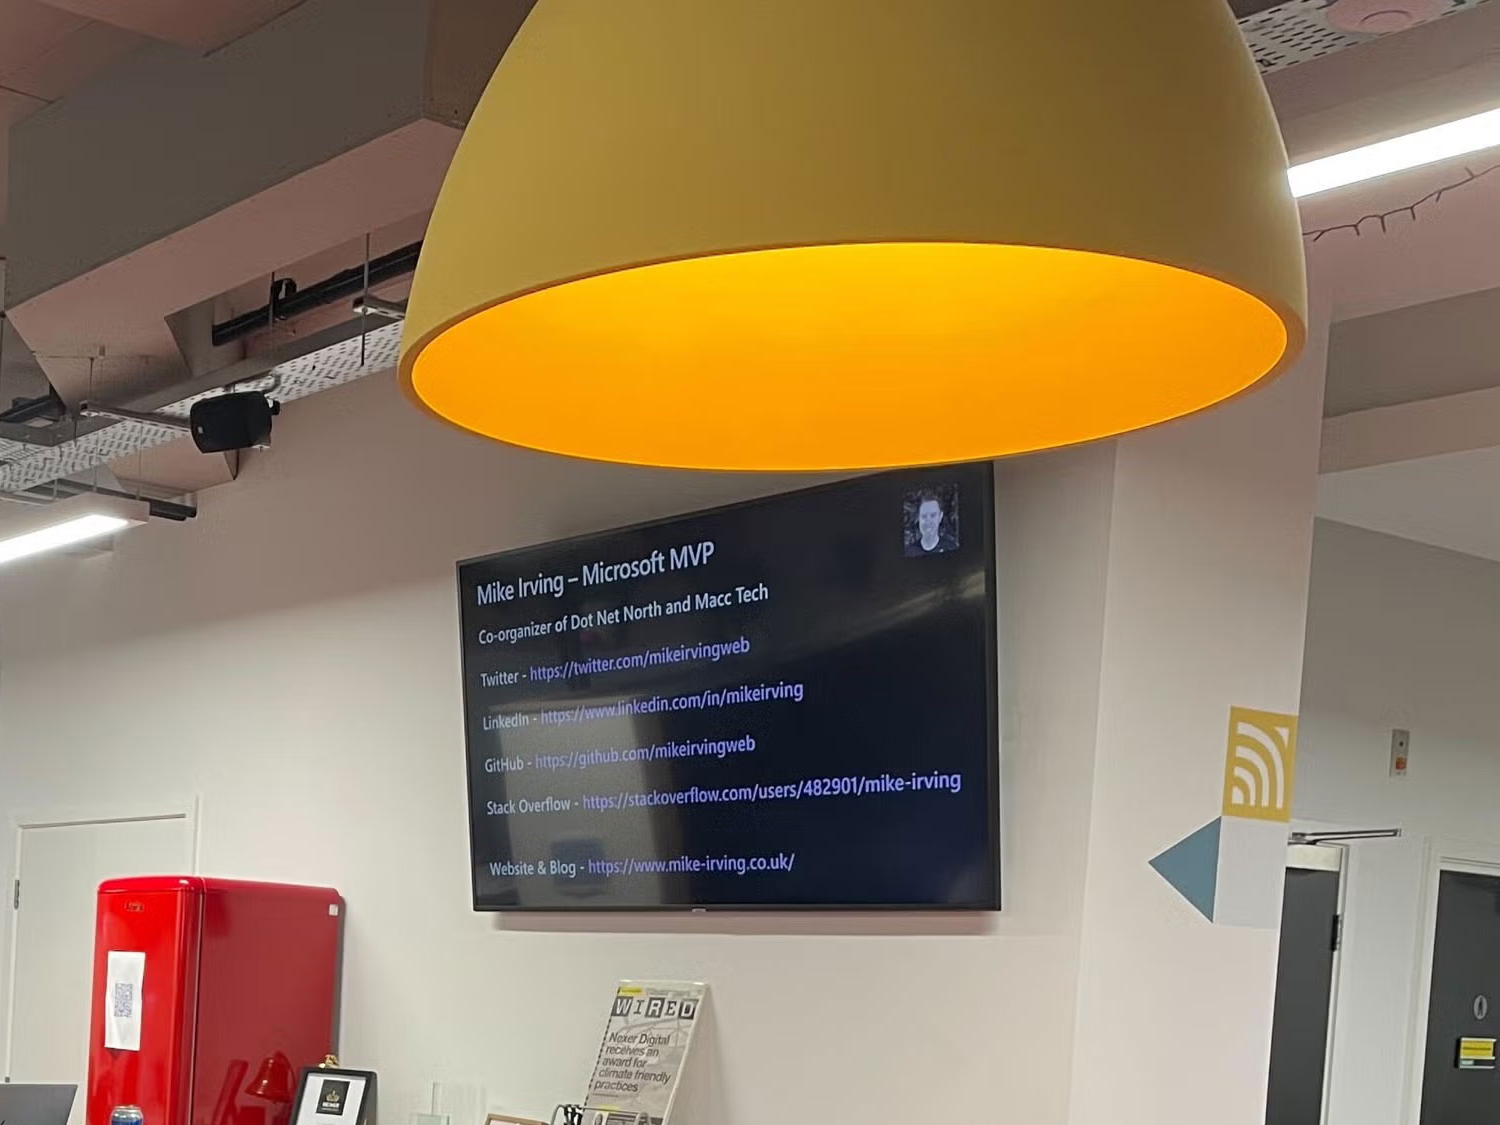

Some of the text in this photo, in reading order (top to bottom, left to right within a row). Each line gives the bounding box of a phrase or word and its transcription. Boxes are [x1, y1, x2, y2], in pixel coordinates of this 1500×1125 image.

[476, 581, 515, 606] Mike
[518, 573, 564, 598] Irving
[582, 550, 665, 587] Microsoft
[670, 541, 715, 570] MVP
[478, 583, 769, 645] Co-organizer of Dot Net North and Macc Tech
[480, 669, 519, 688] Twitter
[529, 636, 750, 682] https://twitter.com/mikeirvingweb
[483, 713, 530, 731] LinkedIn
[540, 681, 804, 726] https://www.linkedin.com/in/mikeirving
[484, 757, 524, 773] GitHub
[535, 735, 756, 770] https://github.com/mikeirvingweb
[487, 800, 516, 815] Stack
[519, 796, 571, 814] Overflow
[582, 770, 962, 811] https://stackoverflow.com/users/482901/mike-irving
[489, 860, 534, 876] Website
[537, 861, 547, 875] &
[549, 860, 576, 878] Blog
[588, 853, 795, 875] https://www.mike-irving.co.uk/
[611, 996, 699, 1020] WIRED
[605, 1045, 659, 1057] receives an
[609, 1031, 671, 1048] Nexer Digital
[602, 1057, 648, 1068] award for
[594, 1080, 638, 1092] practices
[599, 1067, 671, 1085] climate friendly
